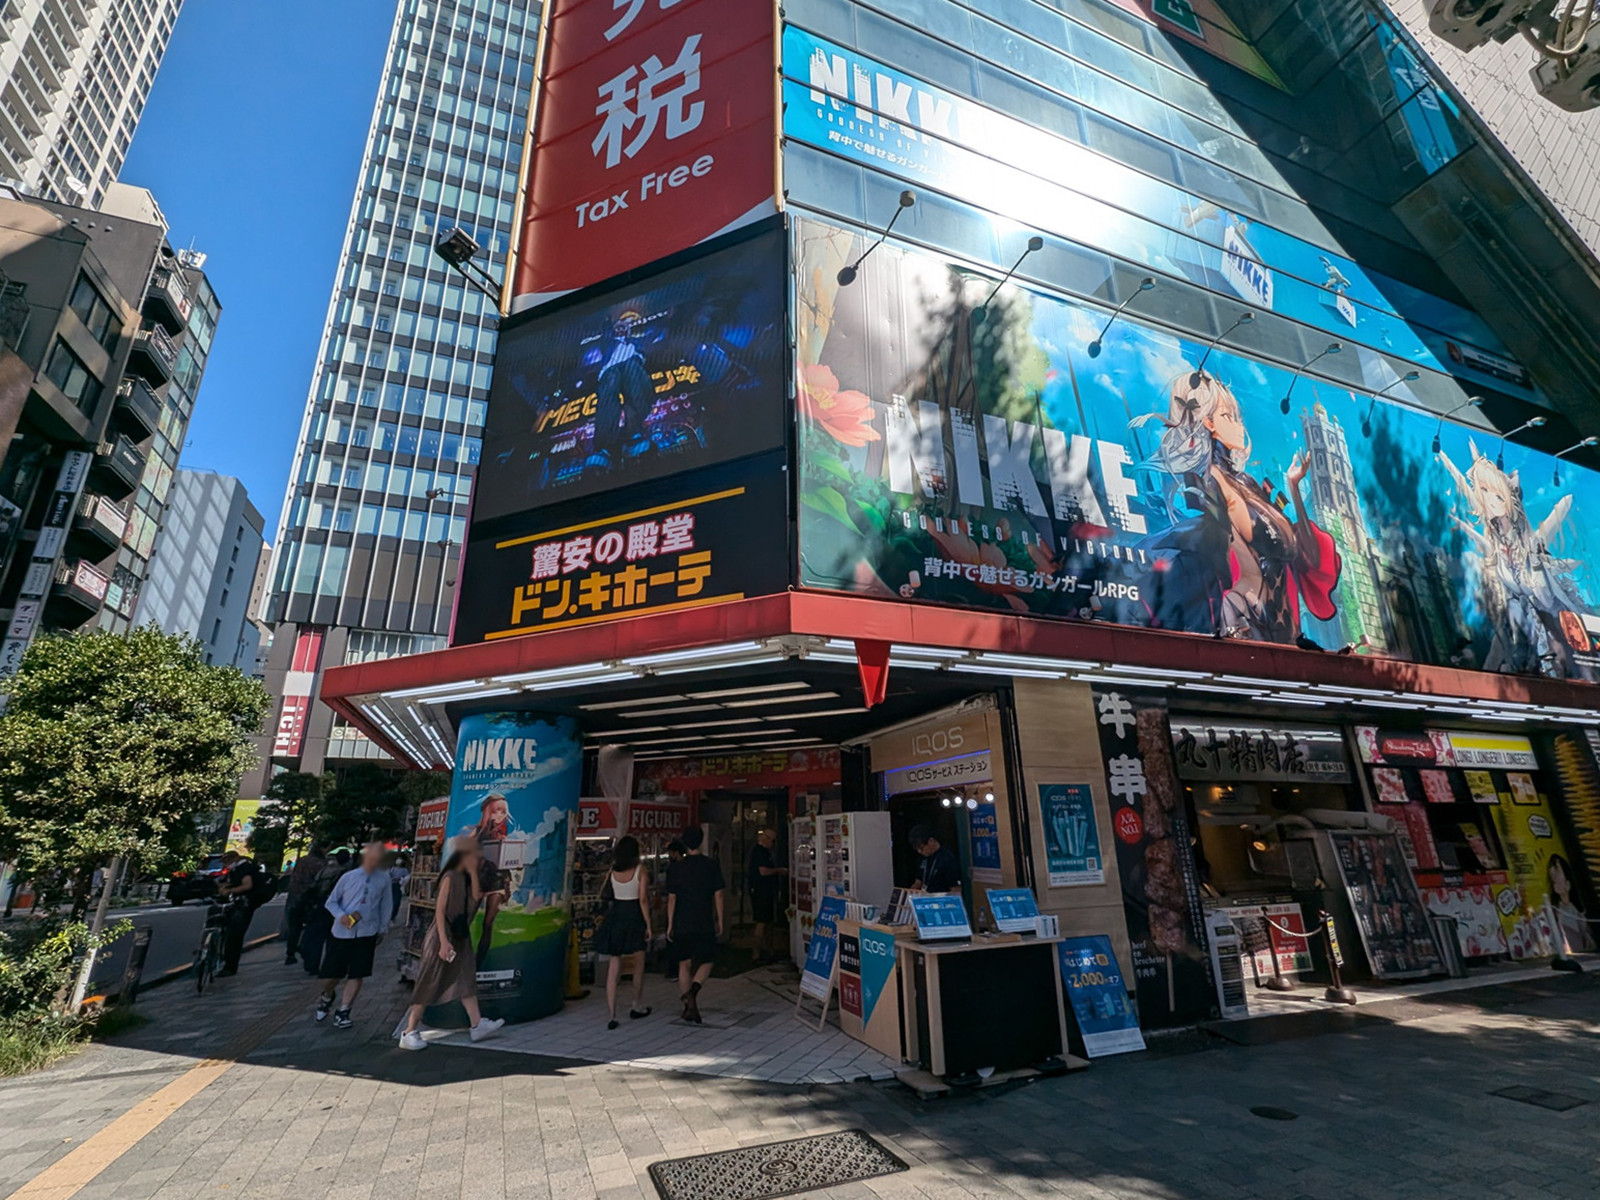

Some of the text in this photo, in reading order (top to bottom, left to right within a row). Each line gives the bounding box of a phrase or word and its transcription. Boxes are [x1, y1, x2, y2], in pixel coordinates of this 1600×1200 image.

[575, 154, 715, 228] Tax Free
[1228, 240, 1269, 304] NIKKE
[885, 393, 1149, 535] NIKKE
[530, 512, 696, 581] 驚安の殿堂
[902, 510, 1148, 566] GODDESS OF VICTORY
[923, 556, 1139, 602] 背中で魅せるガンガールRPG
[462, 738, 538, 772] NIKKE
[912, 726, 964, 756] IQOS
[418, 810, 446, 830] FIGURE
[631, 809, 682, 829] FIGURE
[862, 938, 886, 956] IQOS
